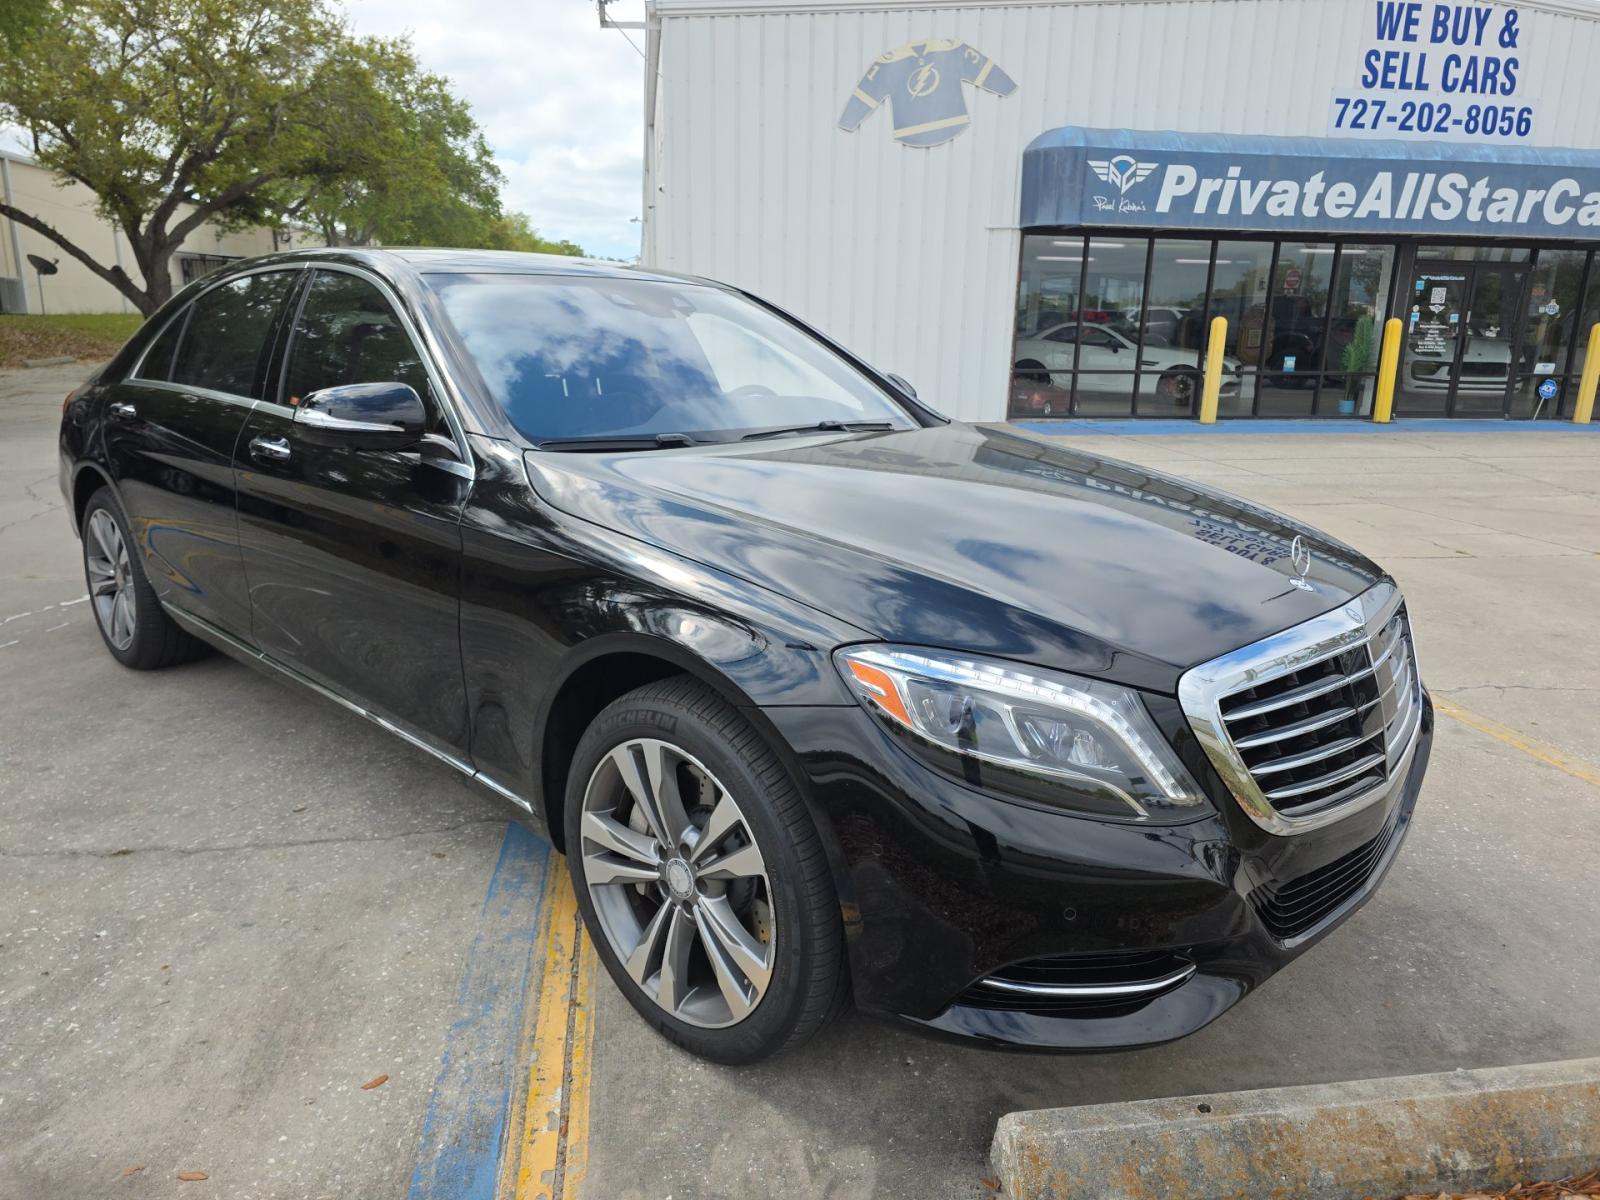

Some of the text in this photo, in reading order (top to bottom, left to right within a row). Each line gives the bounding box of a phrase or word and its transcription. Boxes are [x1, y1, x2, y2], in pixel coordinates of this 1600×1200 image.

[1377, 1, 1519, 48] WE BUY &
[1362, 49, 1519, 96] SELL CARS
[1335, 98, 1532, 136] 727-202-8056
[1156, 165, 1600, 226] PrivateAllStarCa
[600, 711, 672, 731] MICHELIN
